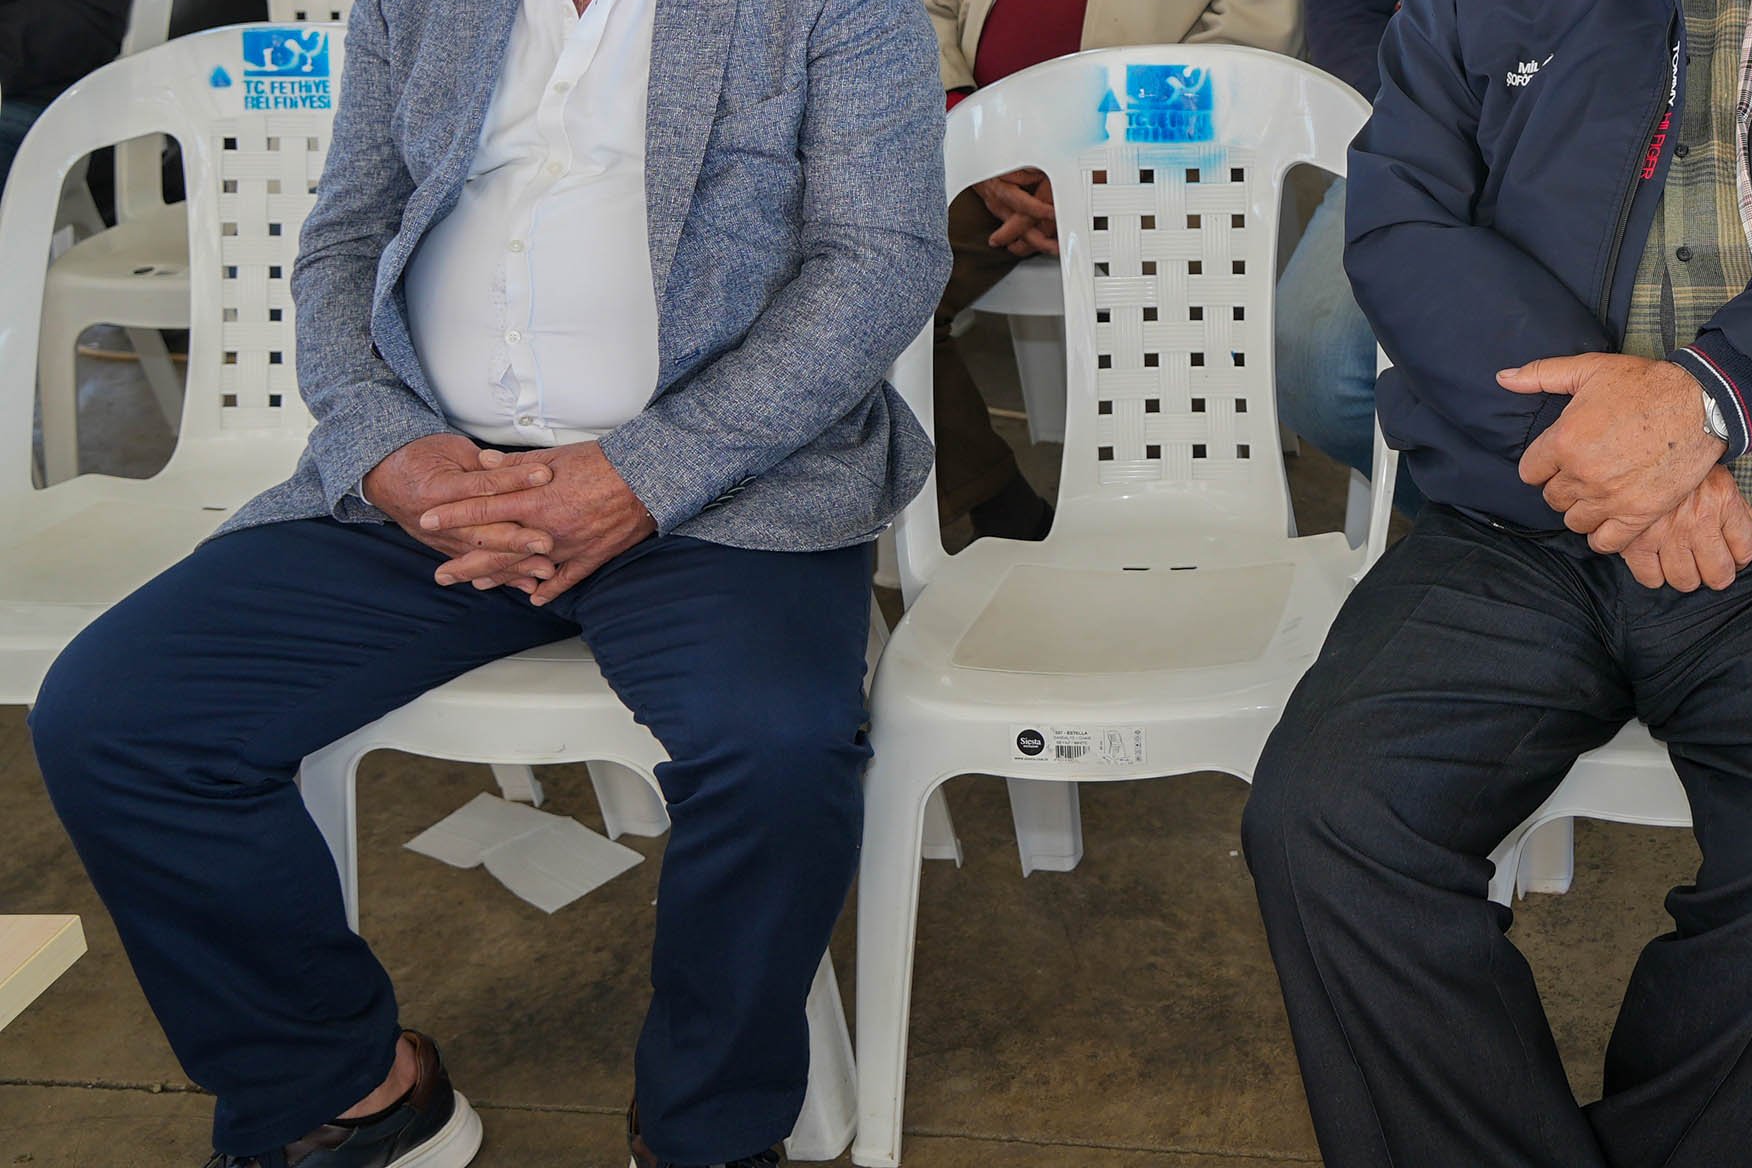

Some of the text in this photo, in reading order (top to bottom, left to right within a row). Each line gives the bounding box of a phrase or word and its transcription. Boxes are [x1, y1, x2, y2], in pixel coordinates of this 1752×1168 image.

[1518, 59, 1540, 73] MİL
[1668, 40, 1681, 107] TOMMY
[1020, 737, 1041, 745] Siesta
